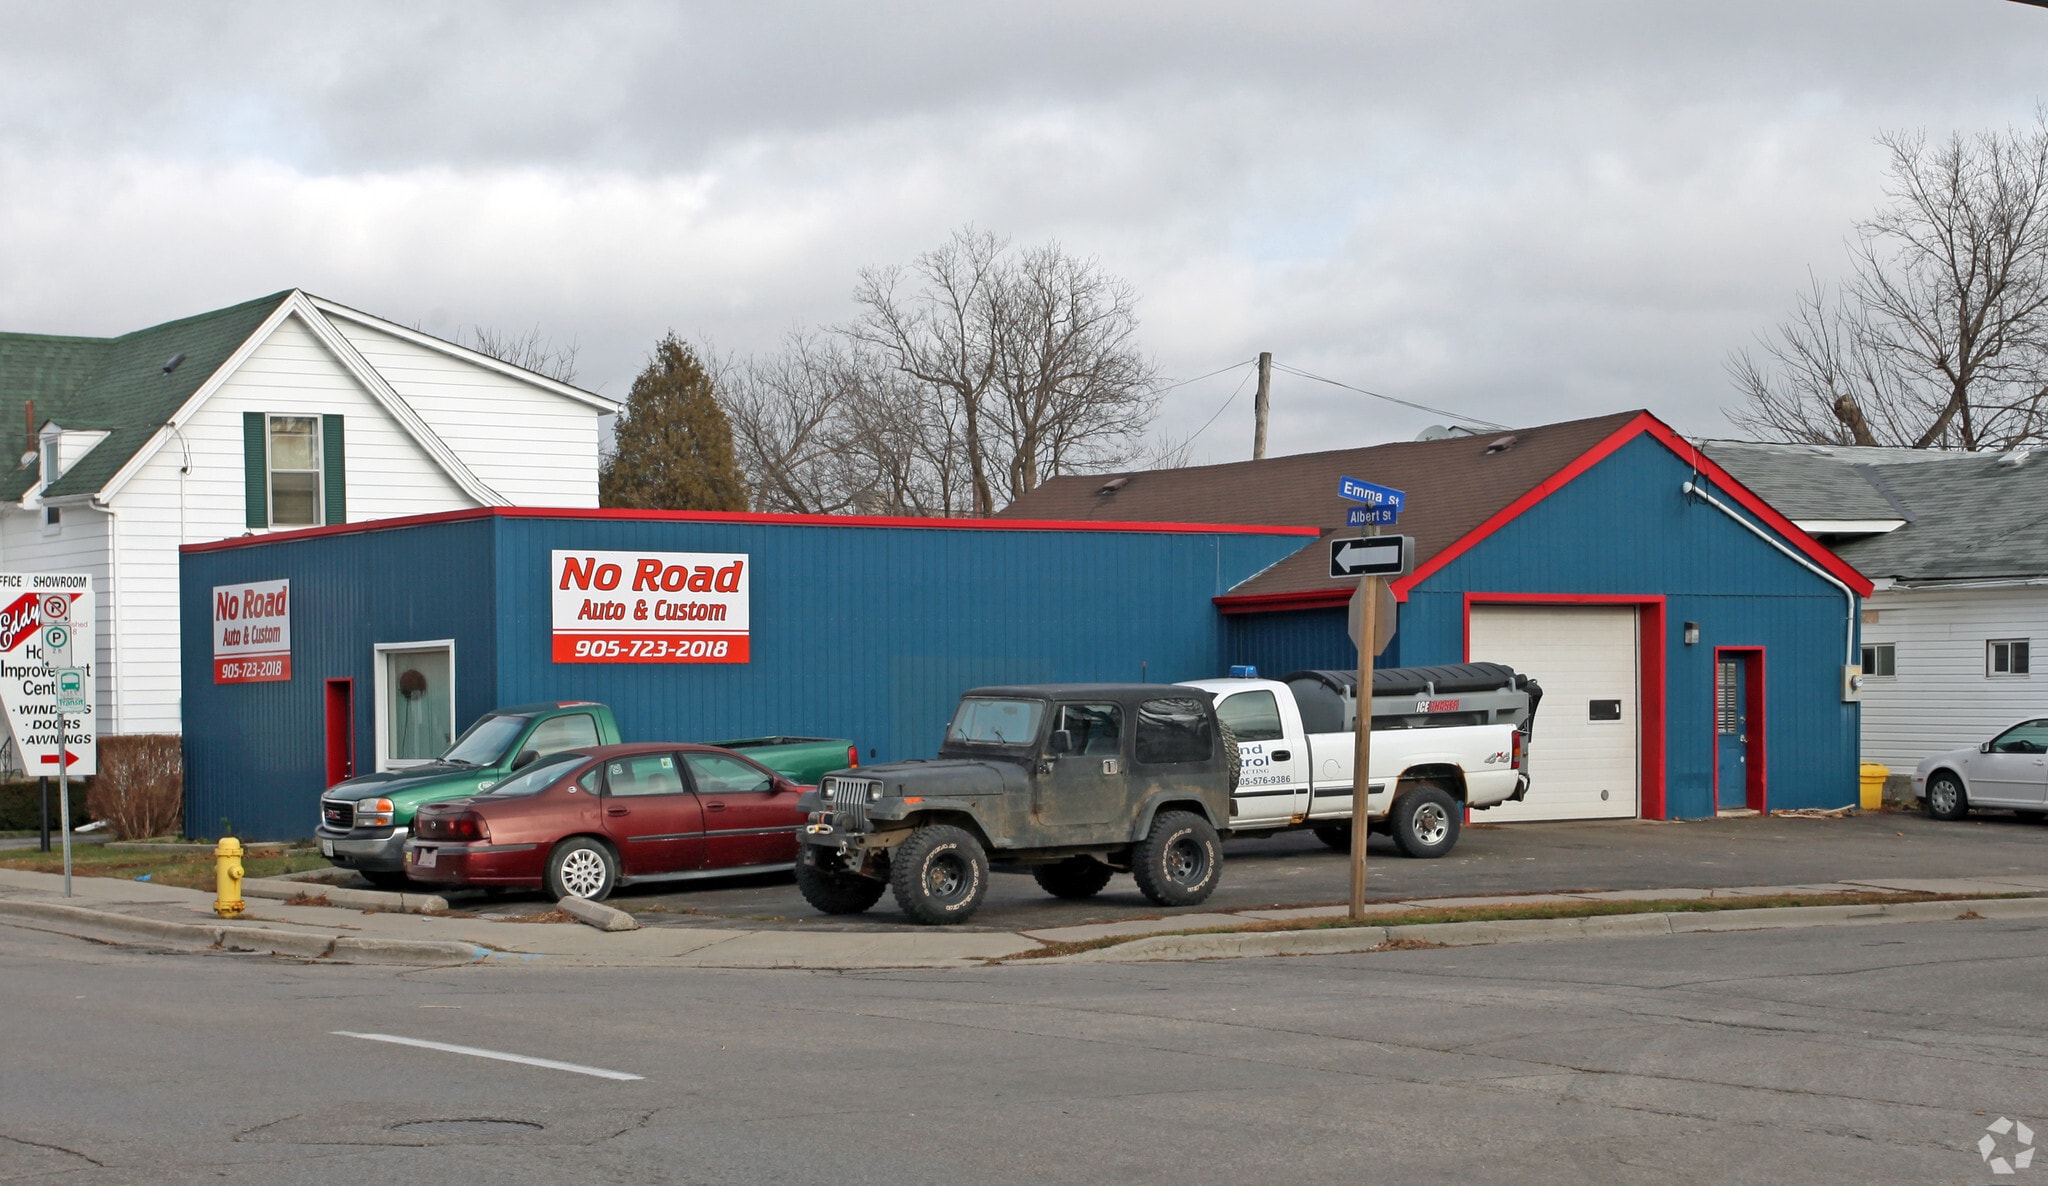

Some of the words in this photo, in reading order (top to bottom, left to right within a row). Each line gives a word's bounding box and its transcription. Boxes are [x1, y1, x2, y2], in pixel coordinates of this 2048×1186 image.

[1343, 481, 1383, 503] Emma
[1388, 495, 1400, 507] St
[1350, 510, 1380, 523] Albert
[1382, 510, 1391, 521] St
[33, 575, 87, 588] SHOWROOM
[559, 557, 622, 591] No
[632, 559, 744, 593] Road
[216, 591, 239, 621] No
[242, 586, 287, 619] Road
[578, 599, 626, 621] Auto
[633, 599, 648, 621] &
[654, 600, 727, 621] Custom
[52, 632, 61, 643] P
[223, 627, 241, 646] Auto
[243, 625, 249, 645] &
[251, 625, 281, 644] Custom
[575, 640, 728, 657] 905-723-2018
[1, 660, 91, 680] Improvet
[222, 661, 282, 678] 905-723-2018
[23, 680, 56, 696] Cent
[19, 705, 92, 715] WINDS
[58, 698, 84, 707] Transit
[26, 734, 92, 745] AWNNGS
[1239, 755, 1269, 767] trol
[1240, 775, 1291, 785] 05-576-9386
